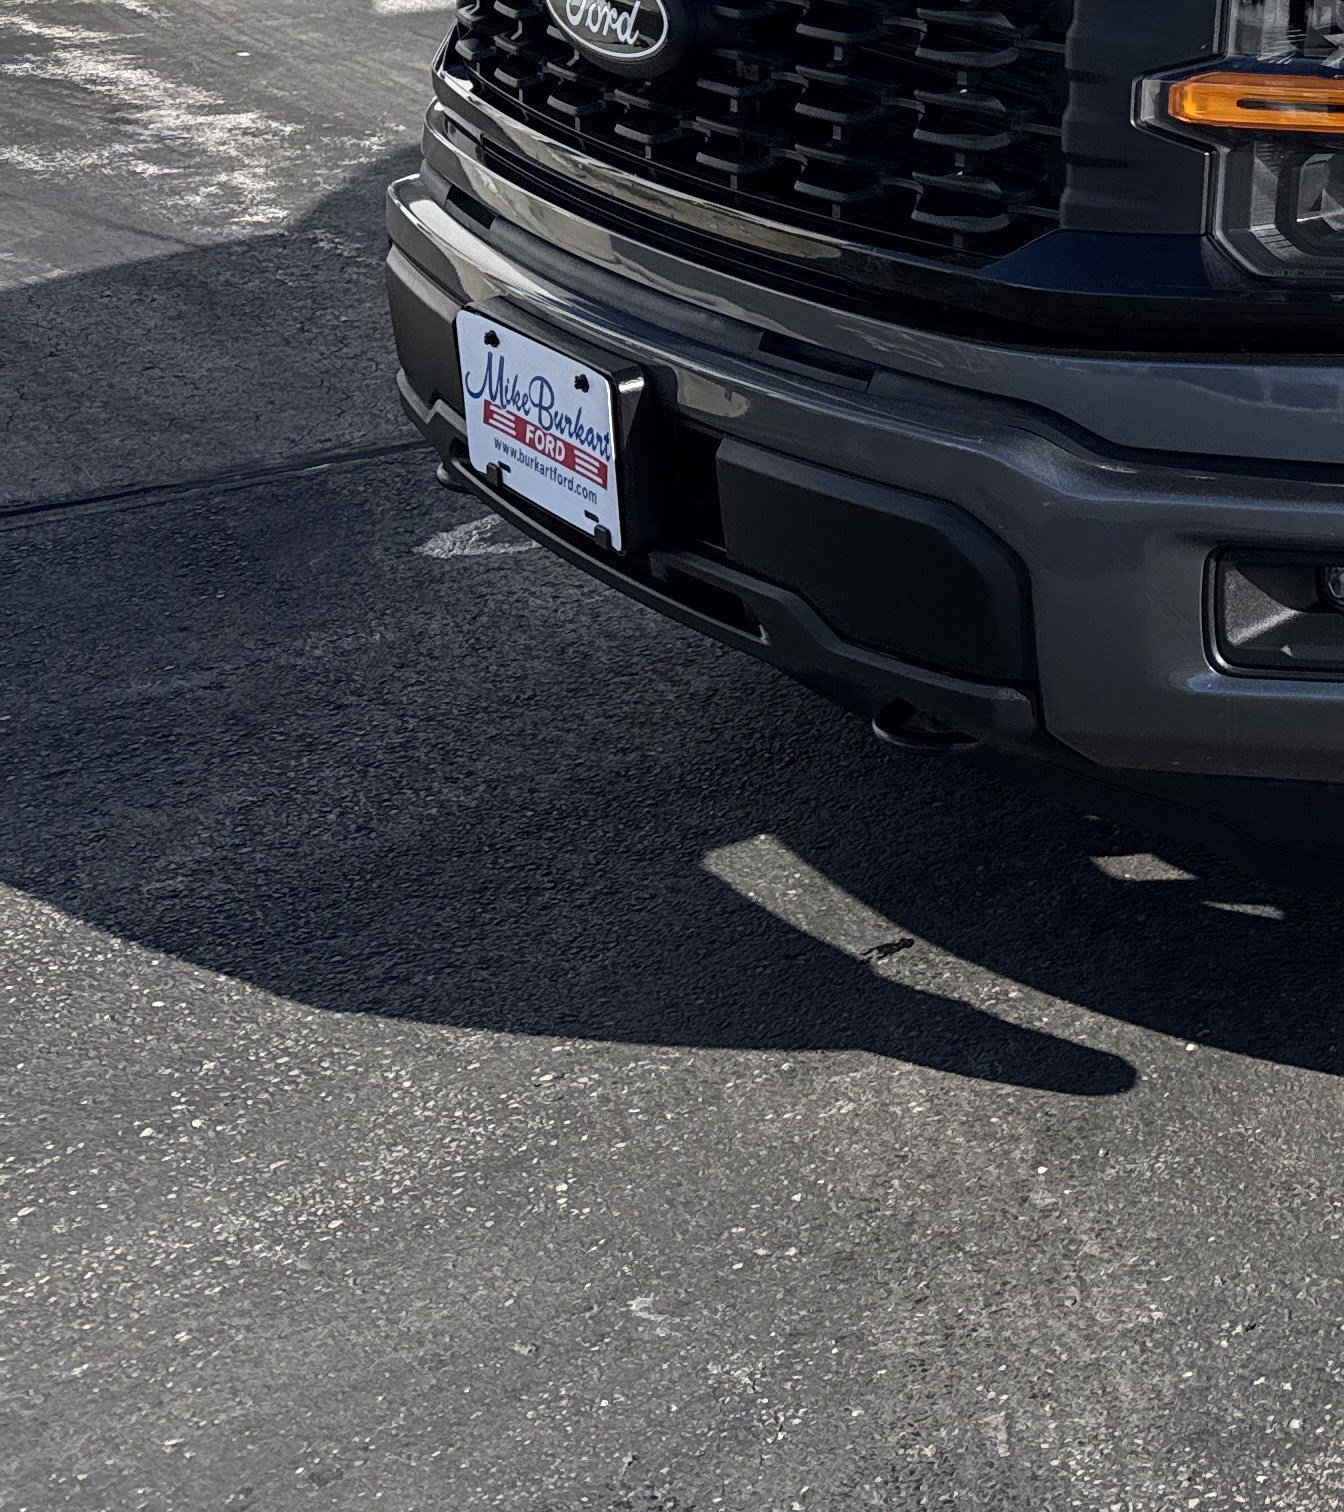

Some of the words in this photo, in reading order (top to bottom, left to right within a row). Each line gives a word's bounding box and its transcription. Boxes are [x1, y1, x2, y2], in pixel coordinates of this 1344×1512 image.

[465, 351, 531, 417] Mike
[529, 375, 611, 463] Burkart
[494, 438, 598, 505] www.burkartford.com
[525, 424, 566, 462] FORD
